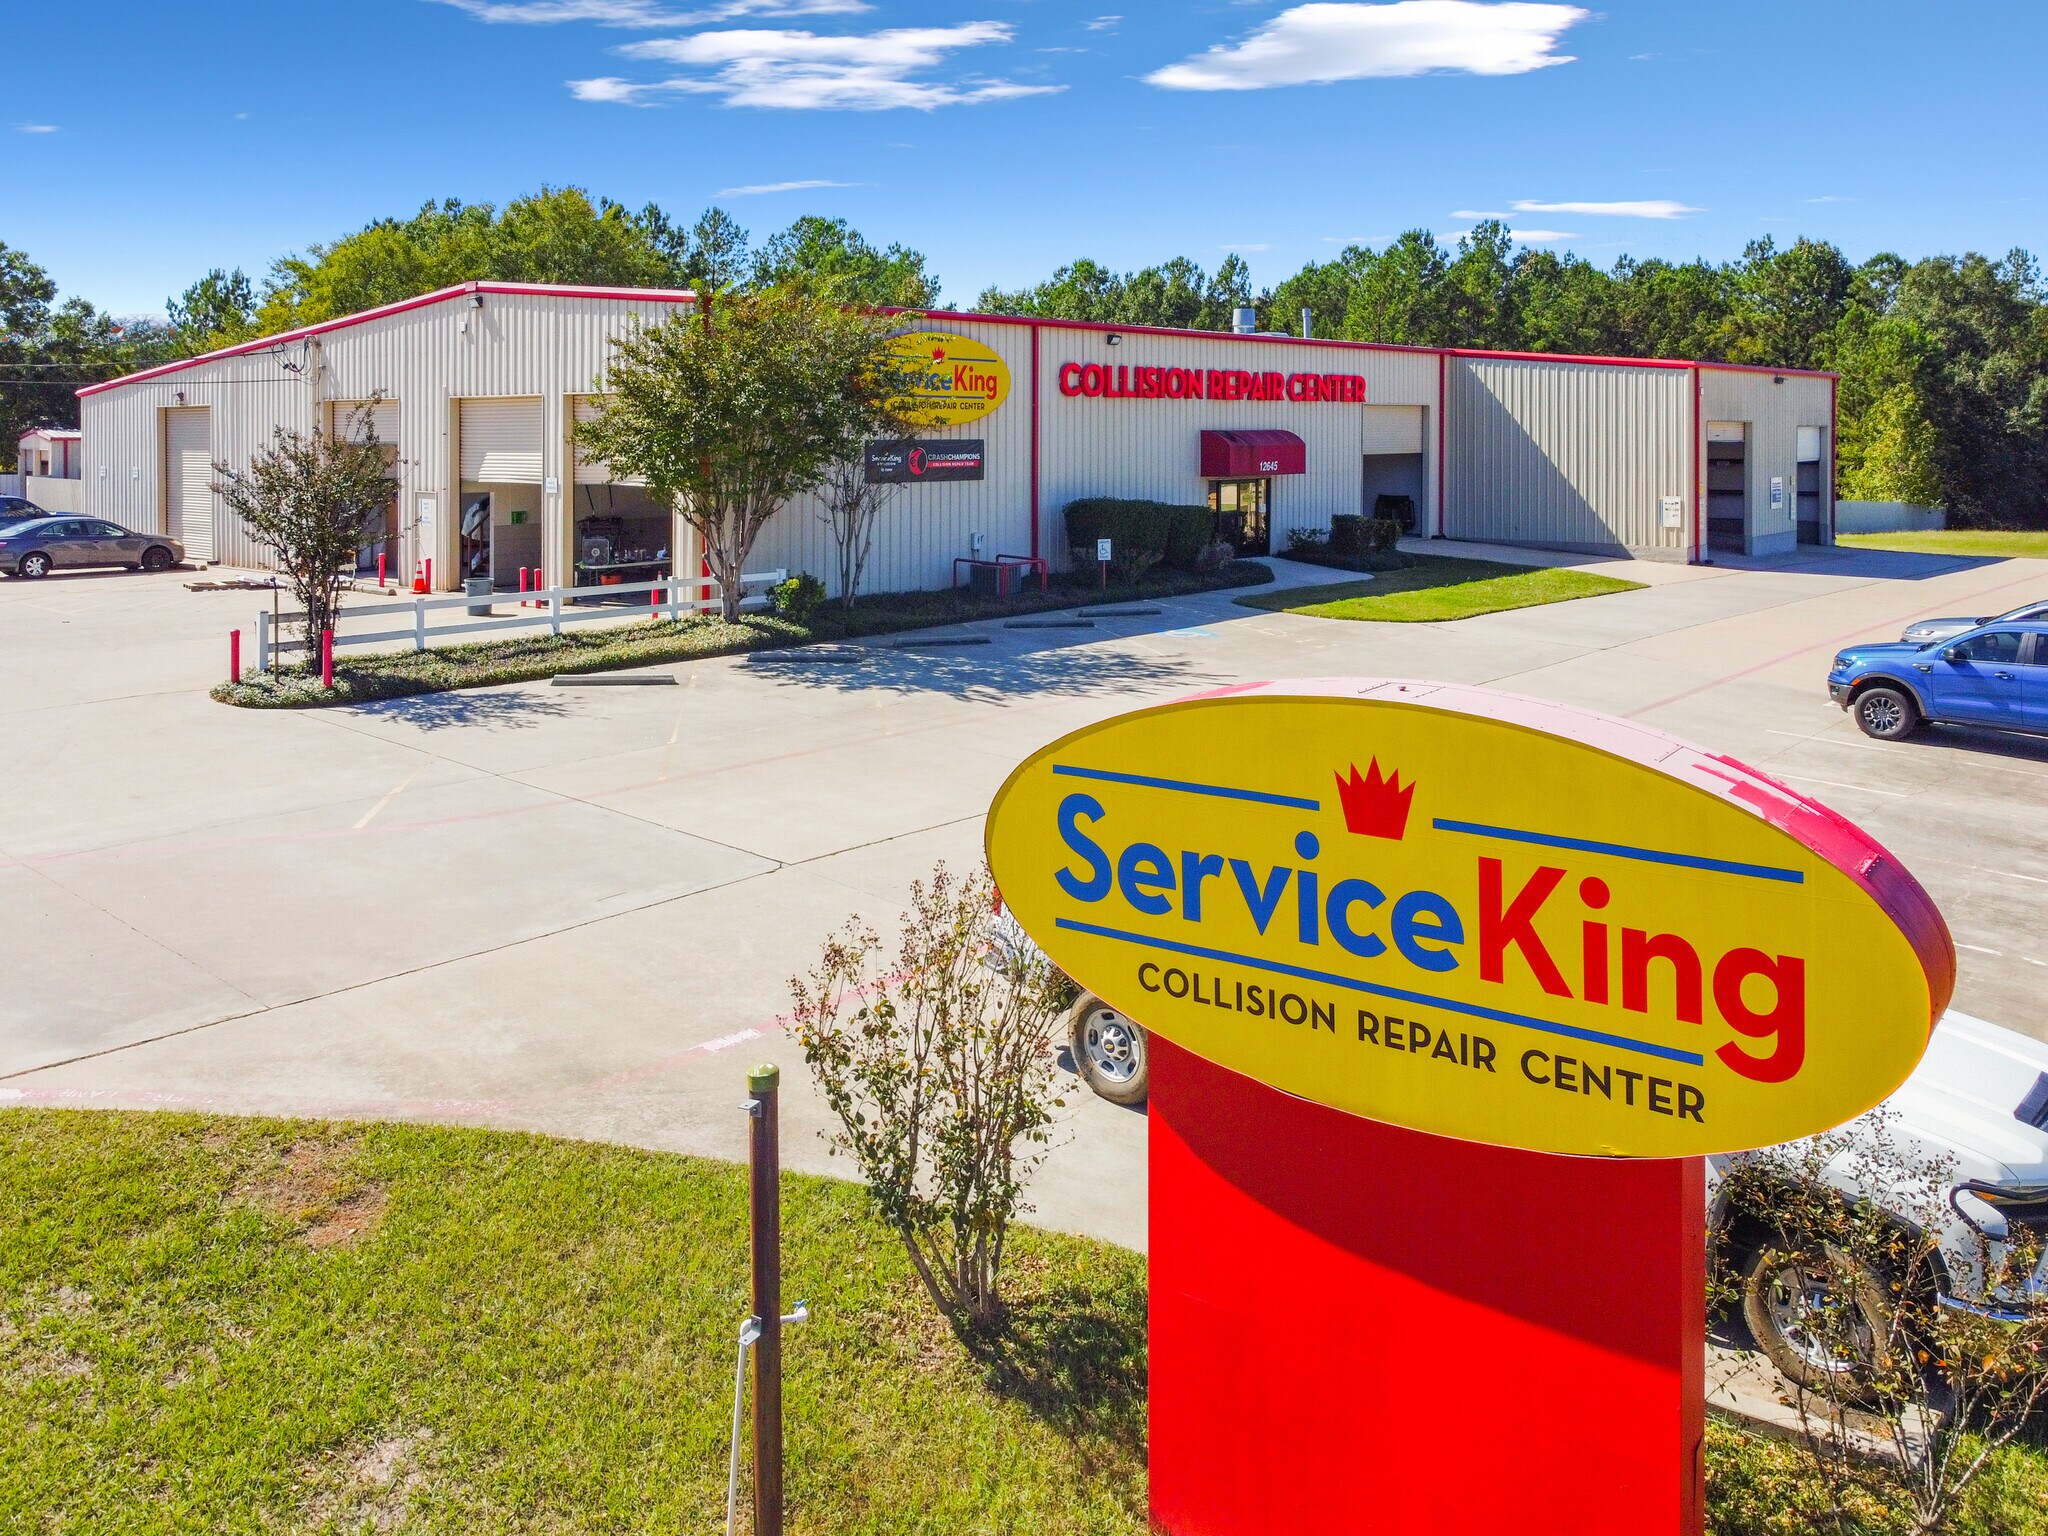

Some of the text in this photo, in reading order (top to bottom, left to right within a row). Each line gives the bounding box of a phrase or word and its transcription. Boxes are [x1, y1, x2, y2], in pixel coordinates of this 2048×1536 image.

[1059, 362, 1367, 402] COLLISION REPAIR CENTER
[960, 402, 985, 410] CENTER
[1259, 461, 1278, 472] 12645
[1138, 962, 1705, 1124] COLLISION REPAIR CENTER
